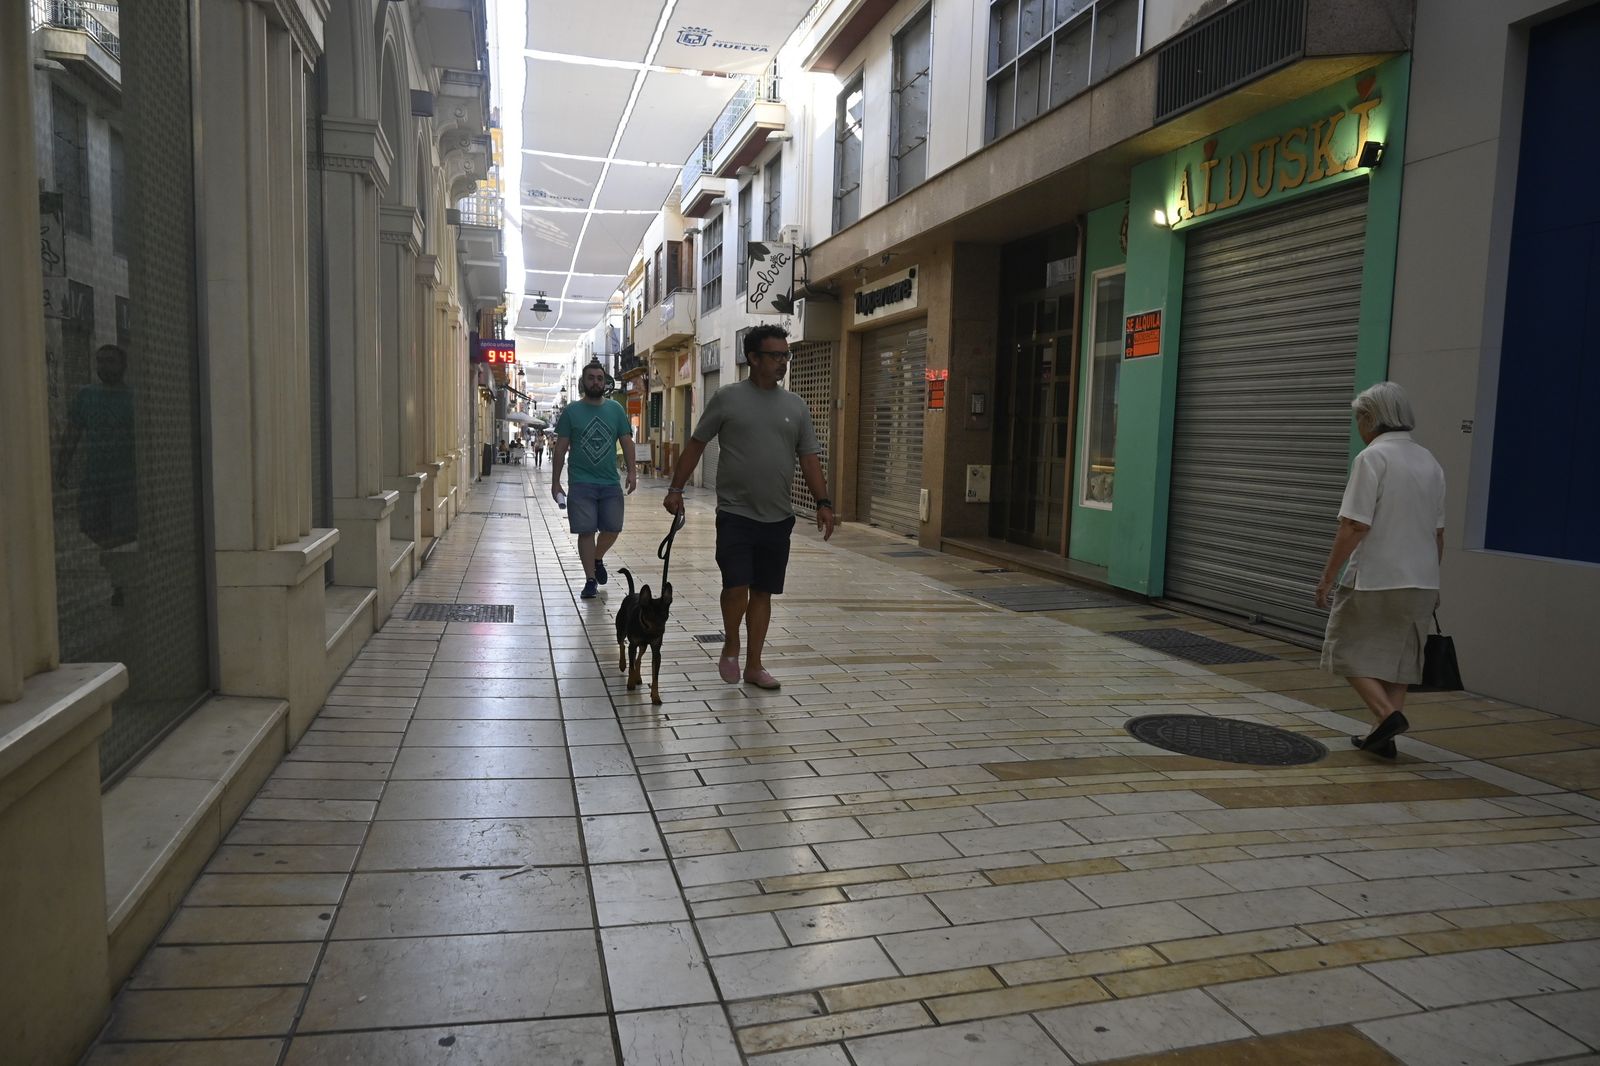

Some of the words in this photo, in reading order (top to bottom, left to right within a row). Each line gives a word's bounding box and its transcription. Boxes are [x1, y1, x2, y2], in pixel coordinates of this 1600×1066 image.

[712, 42, 769, 52] HUELVA
[1127, 318, 1135, 332] SE
[1135, 312, 1161, 331] ALQUILA
